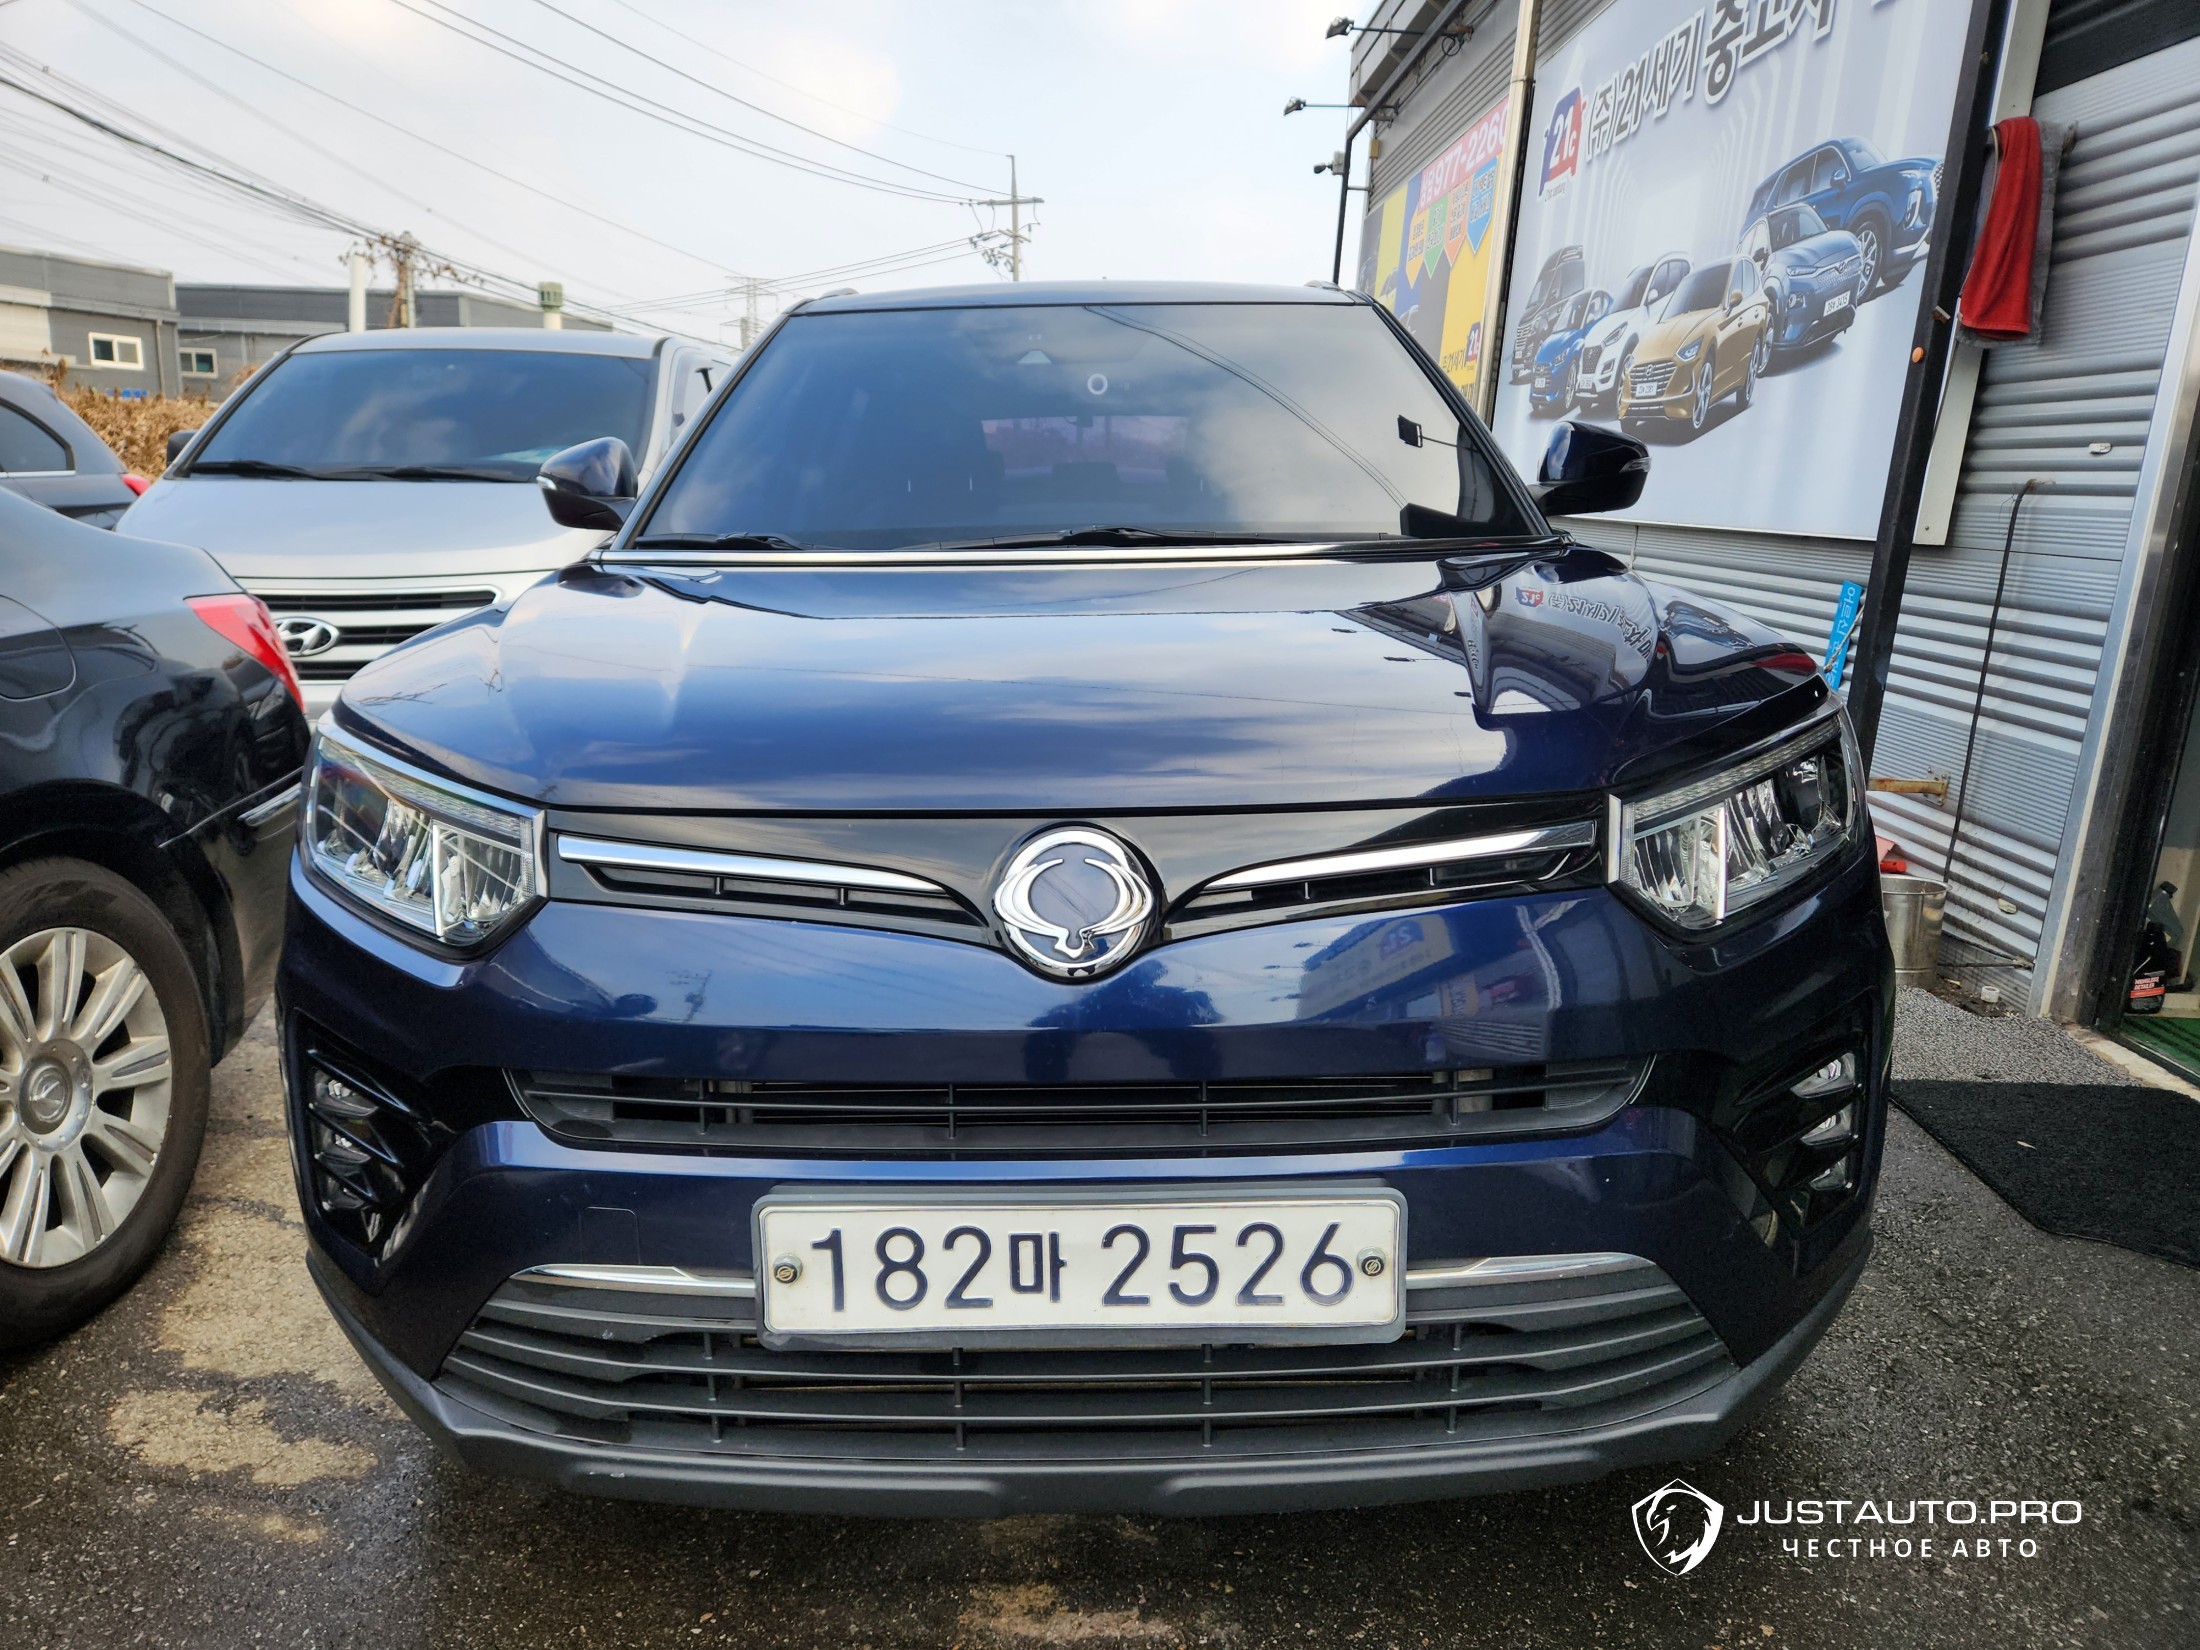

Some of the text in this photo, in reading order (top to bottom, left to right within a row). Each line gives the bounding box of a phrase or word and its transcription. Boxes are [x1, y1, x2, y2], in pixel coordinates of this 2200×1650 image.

[1837, 586, 1856, 635] 어르신
[809, 1221, 1356, 1314] 182마 2526
